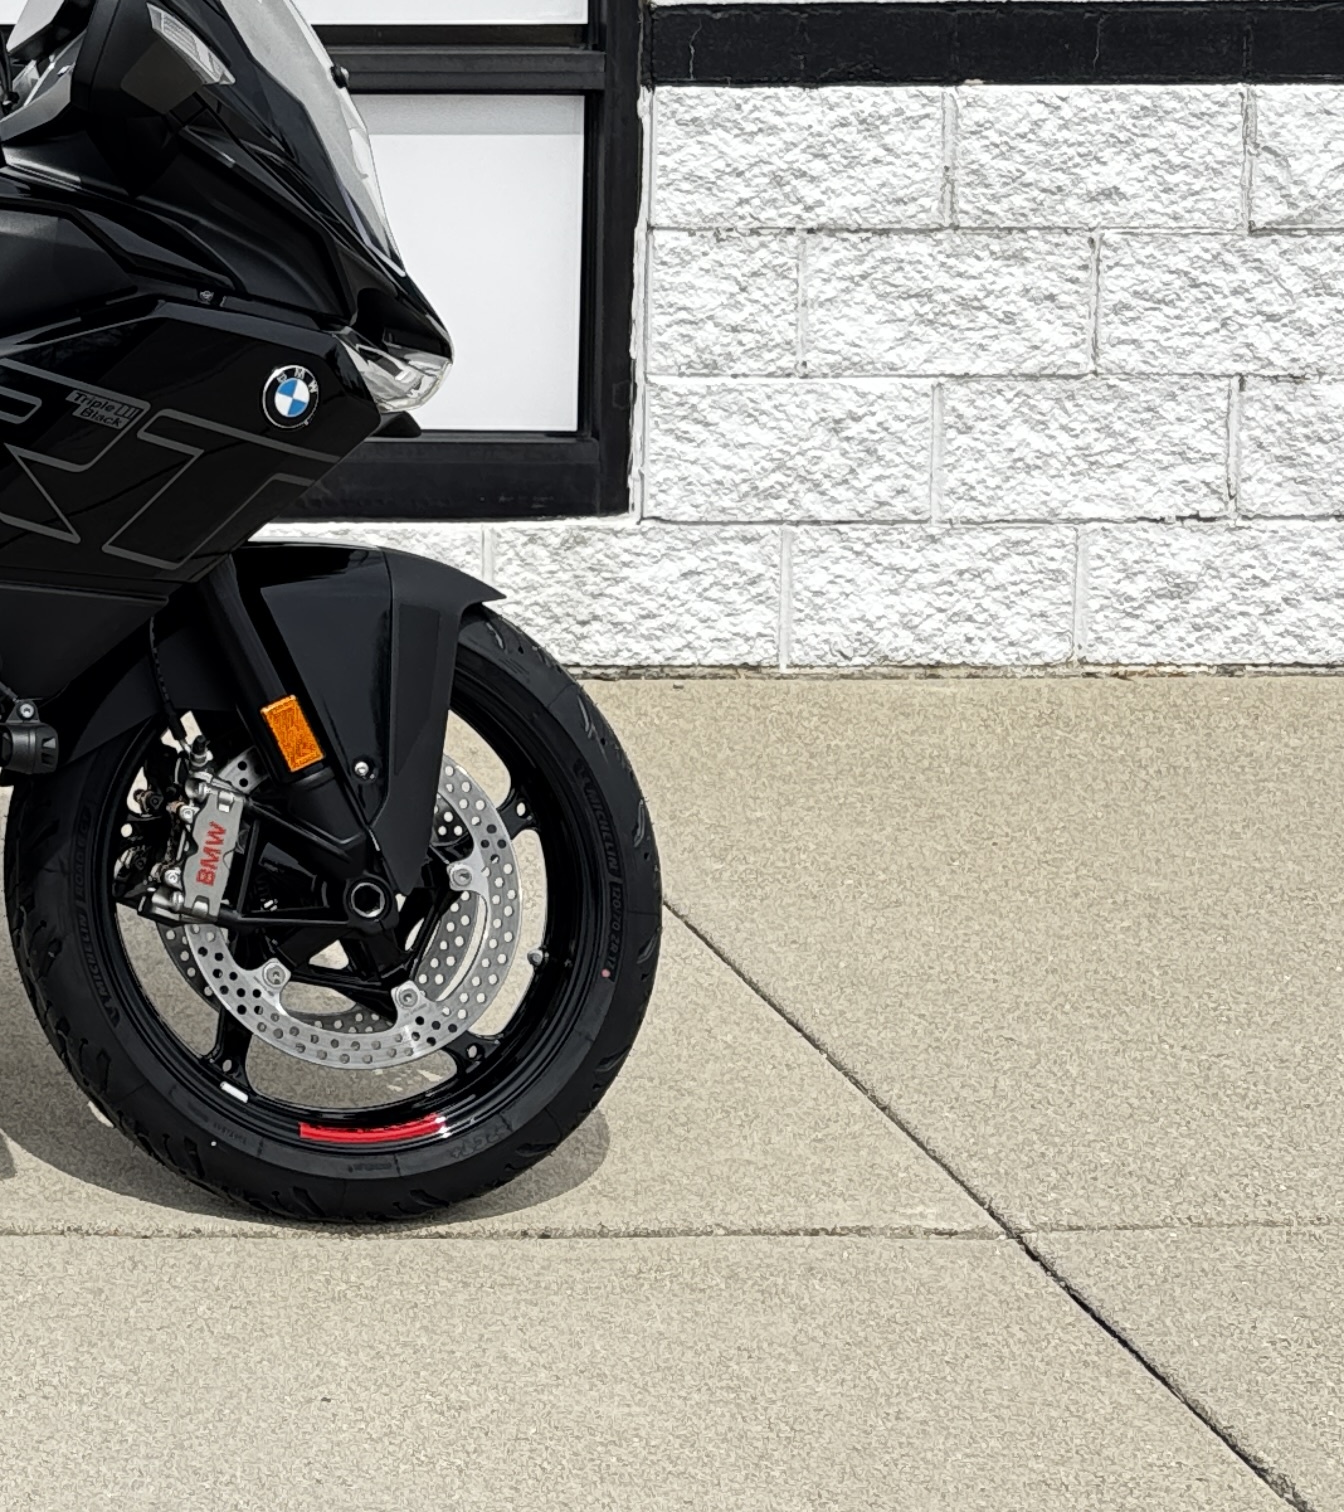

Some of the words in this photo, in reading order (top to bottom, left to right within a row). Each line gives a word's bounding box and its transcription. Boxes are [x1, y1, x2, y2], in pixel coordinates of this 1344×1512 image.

[276, 367, 318, 394] BMW
[73, 391, 116, 412] Triple
[80, 407, 123, 428] Black
[586, 787, 620, 871] MICHELIN
[195, 820, 227, 887] BMW
